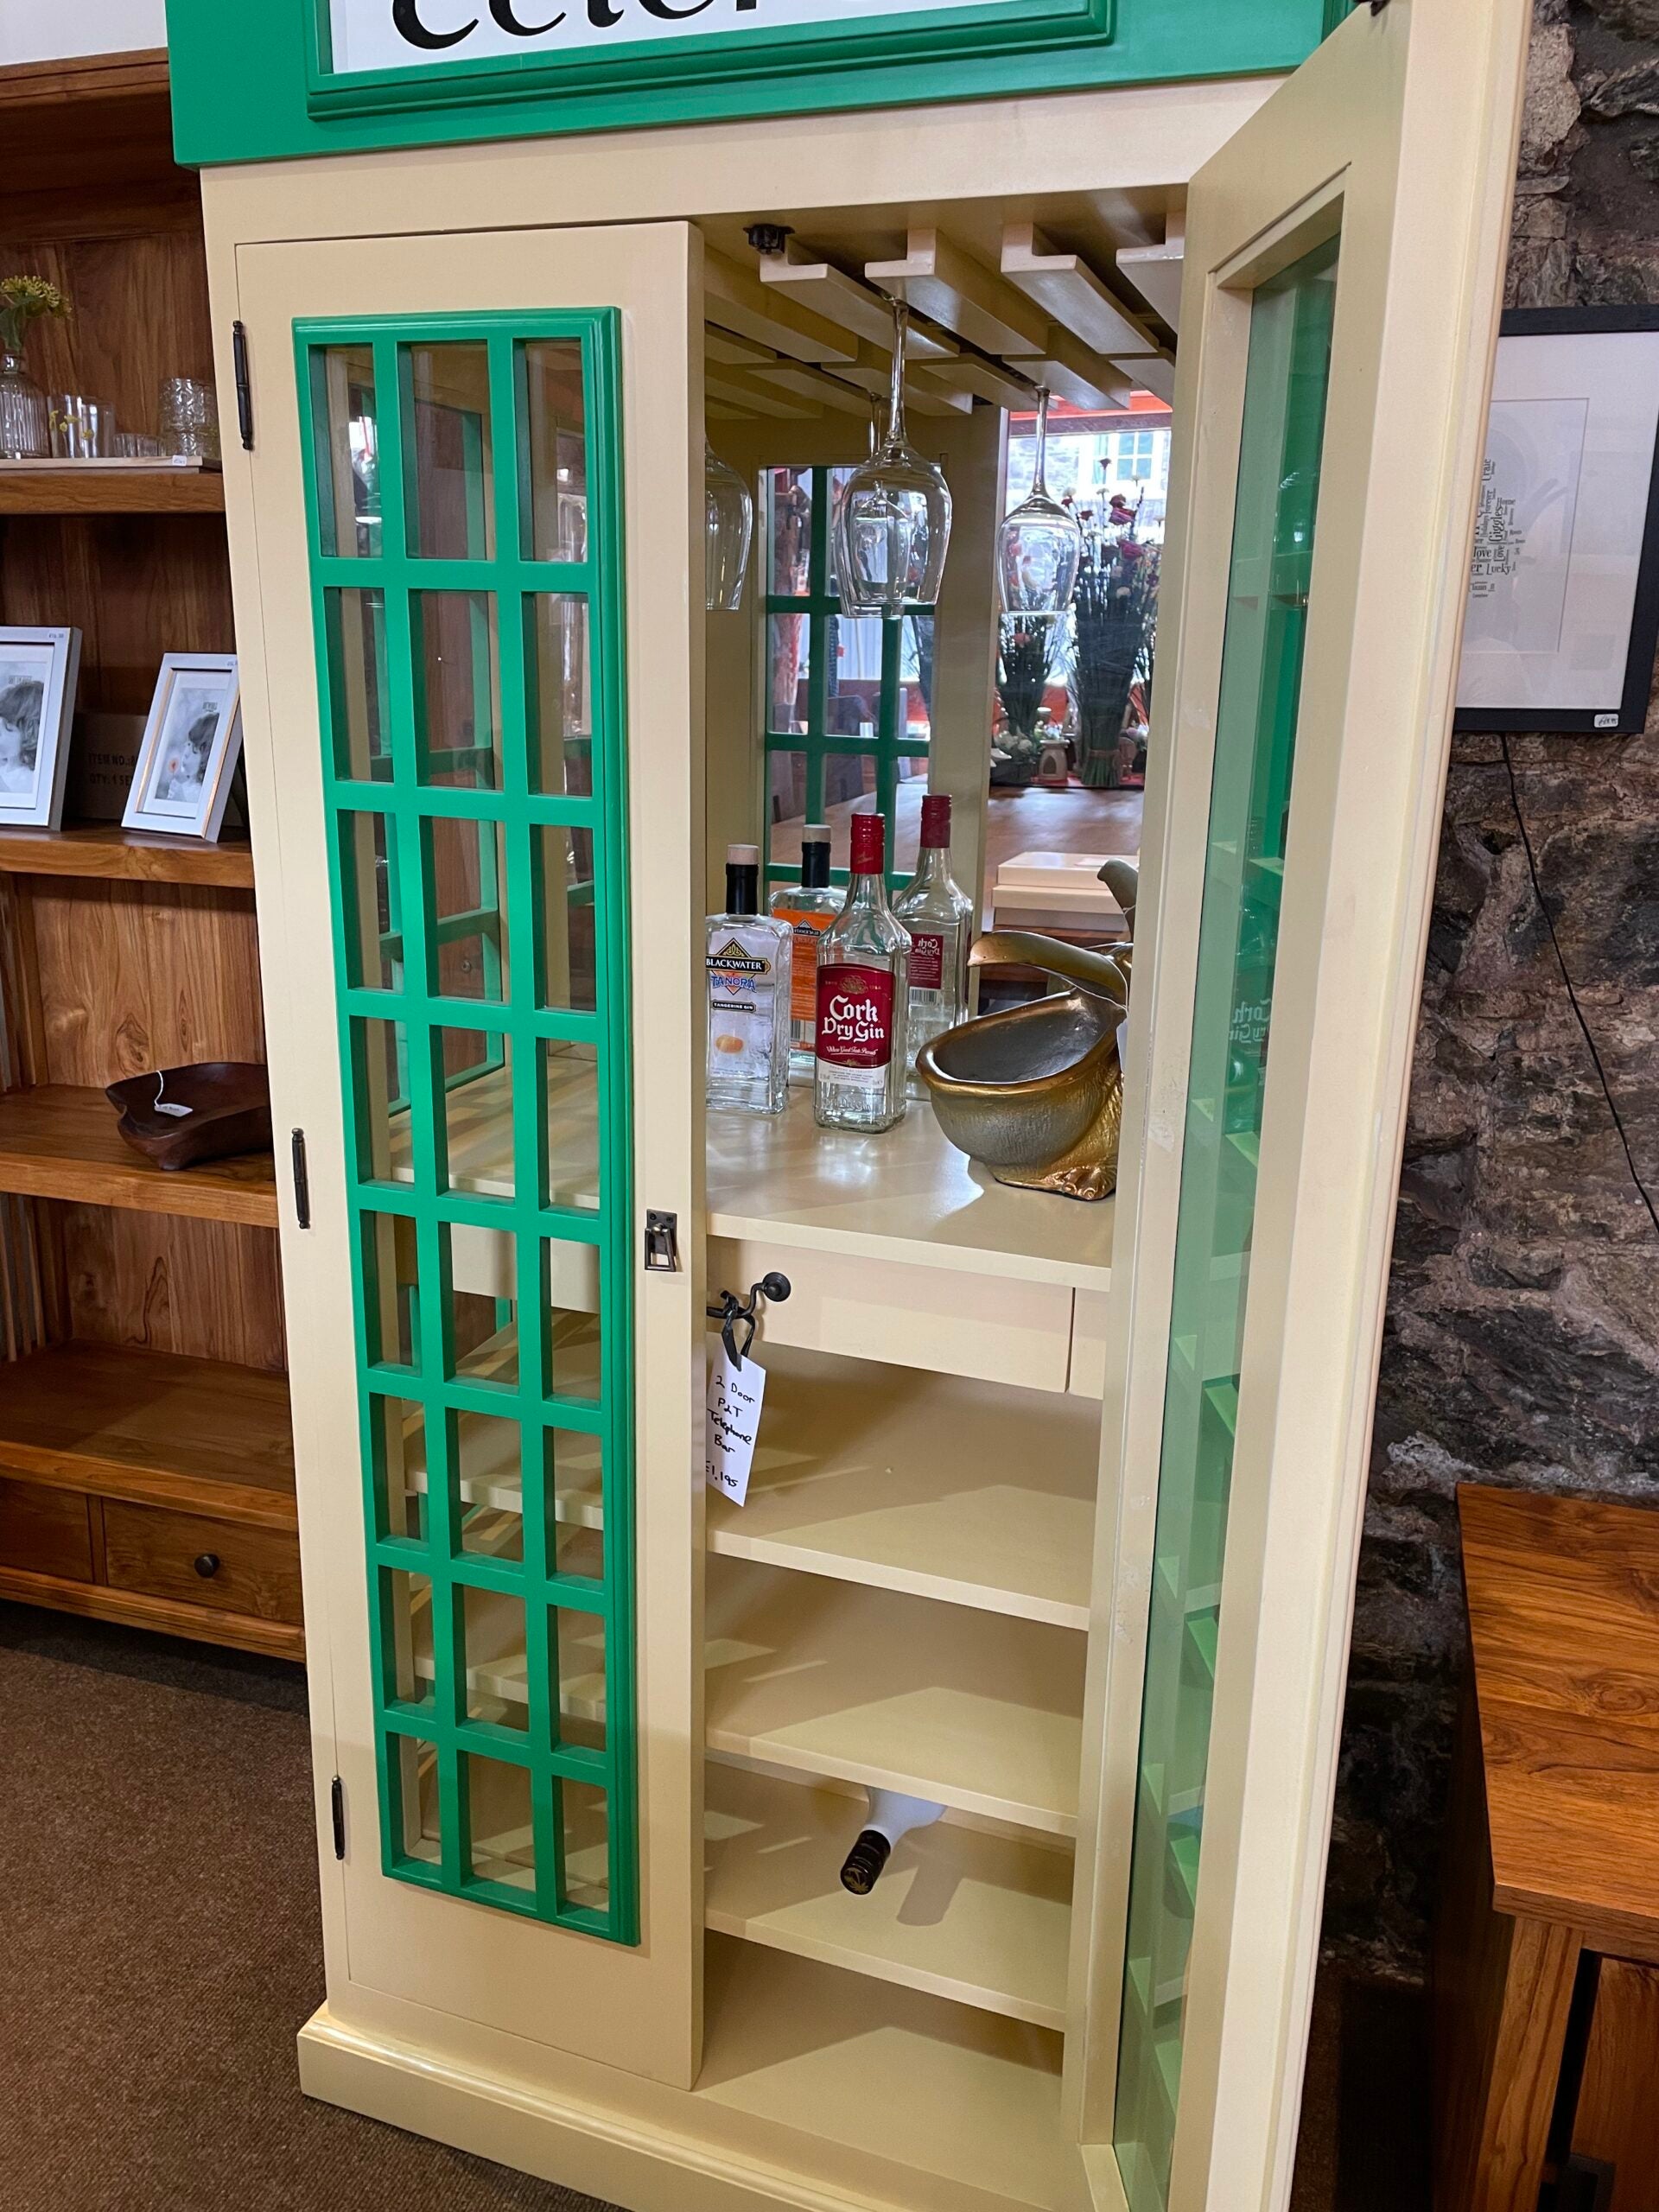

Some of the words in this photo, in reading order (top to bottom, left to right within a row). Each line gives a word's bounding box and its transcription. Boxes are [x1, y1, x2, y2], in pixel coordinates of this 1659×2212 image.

[1489, 505, 1505, 542] Giggles
[1486, 563, 1510, 575] Lucky
[706, 958, 762, 970] BLACKWATER
[711, 976, 757, 993] TANORA
[830, 995, 879, 1023] Cork
[822, 1016, 854, 1041] Dry
[853, 1021, 885, 1043] Gin
[715, 1375, 725, 1389] 2
[730, 1382, 755, 1404] Door
[707, 1408, 753, 1446] Telephone
[714, 1434, 735, 1454] Bar
